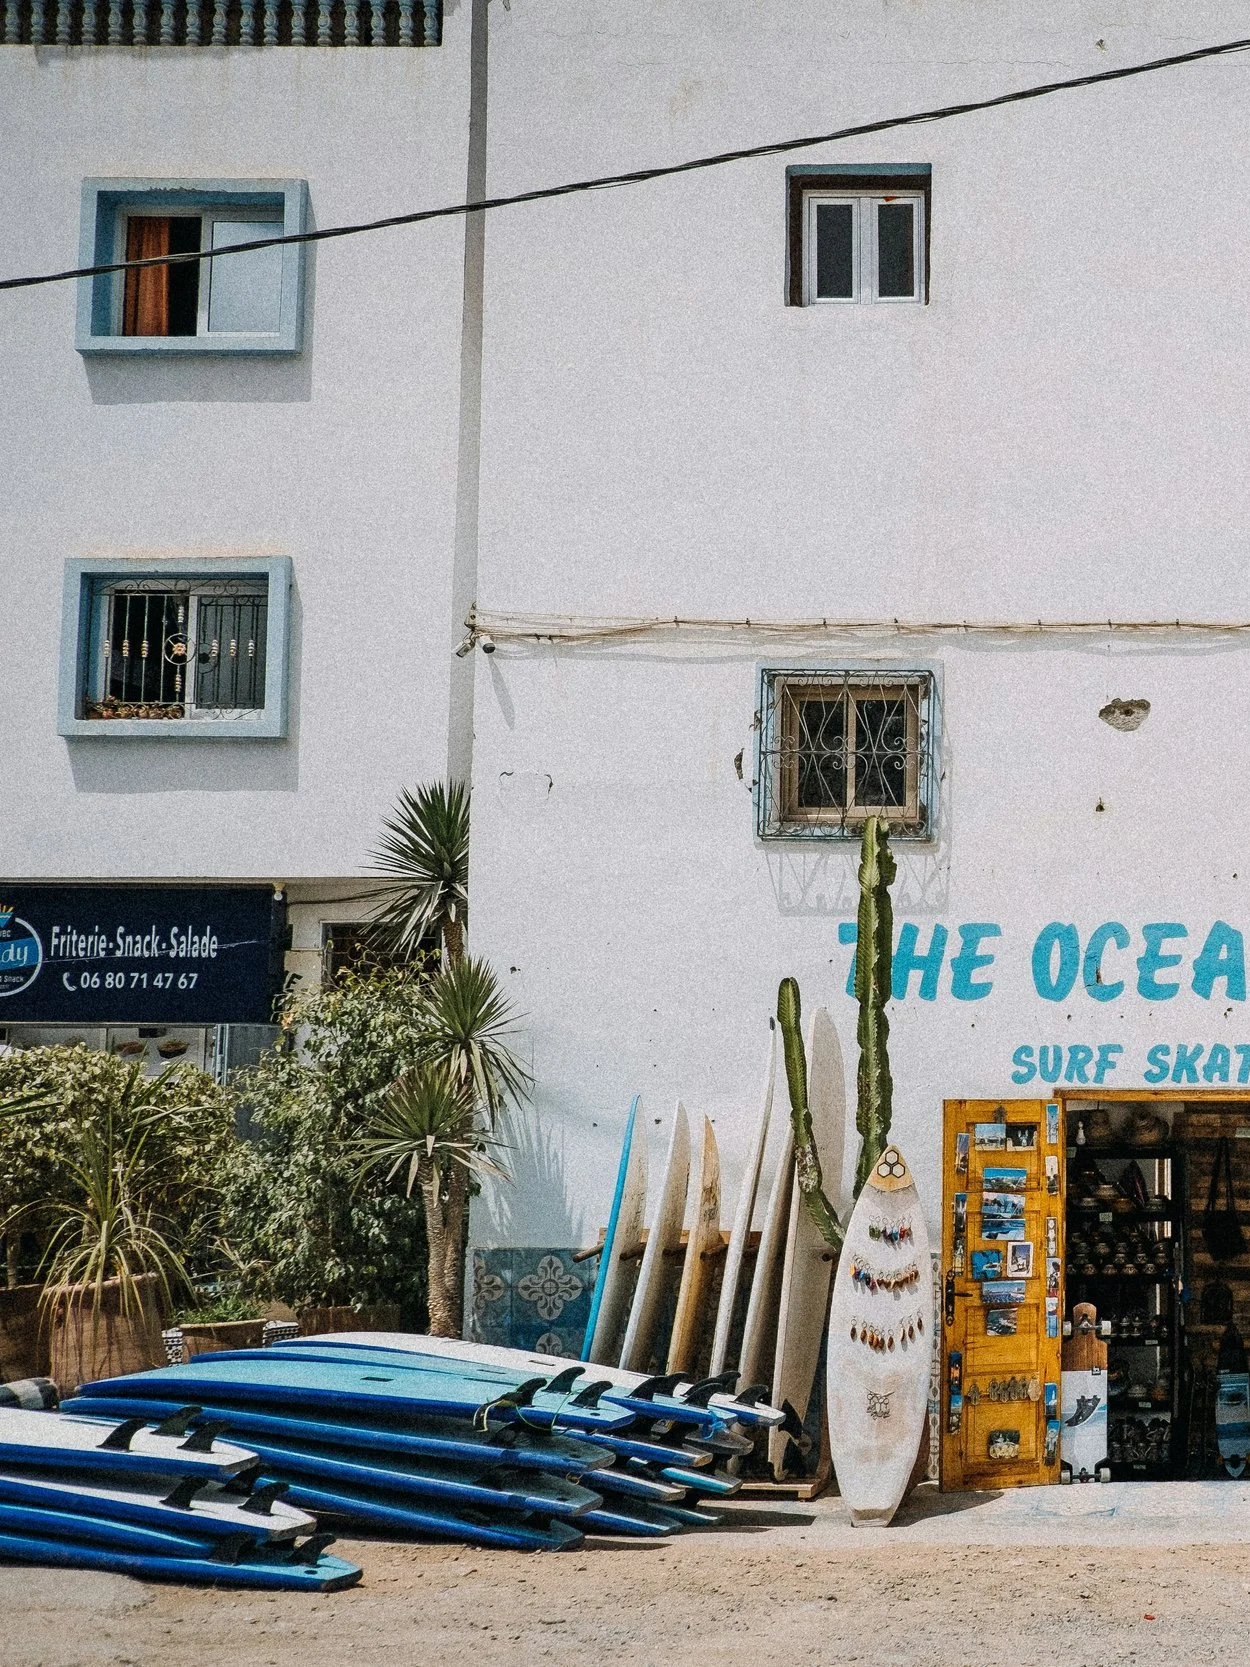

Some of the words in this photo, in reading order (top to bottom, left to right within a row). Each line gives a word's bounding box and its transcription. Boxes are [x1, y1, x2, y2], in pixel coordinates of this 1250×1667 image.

[51, 925, 107, 957] Friterie
[115, 925, 160, 958] Snack
[169, 925, 218, 958] Salade
[80, 972, 100, 989] 06
[105, 972, 125, 989] 80
[130, 972, 148, 989] 71
[153, 972, 174, 989] 47
[178, 972, 198, 989] 67
[1011, 1044, 1124, 1085] SURF
